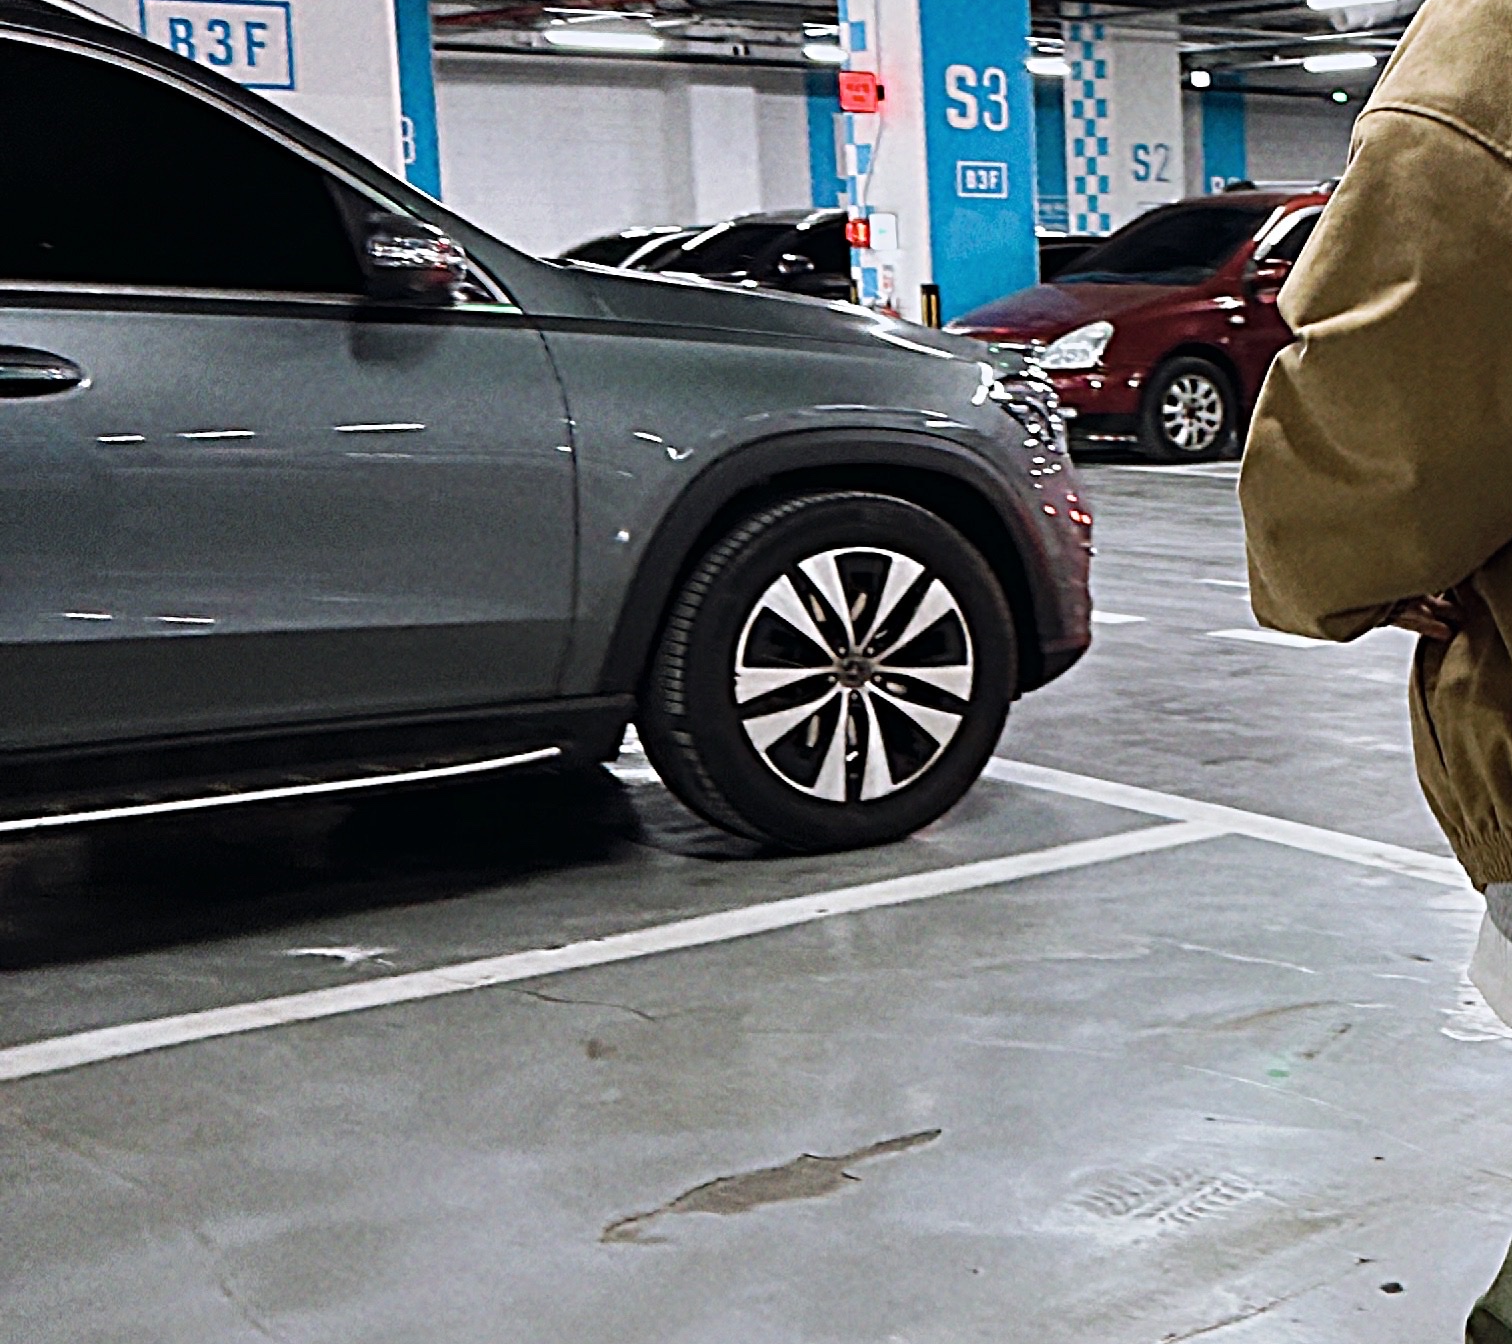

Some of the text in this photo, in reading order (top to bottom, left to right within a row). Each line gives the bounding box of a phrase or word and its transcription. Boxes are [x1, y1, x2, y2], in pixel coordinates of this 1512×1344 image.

[168, 16, 268, 67] B3F
[944, 63, 1010, 132] S3
[965, 169, 999, 190] B3F
[1132, 142, 1171, 182] S2
